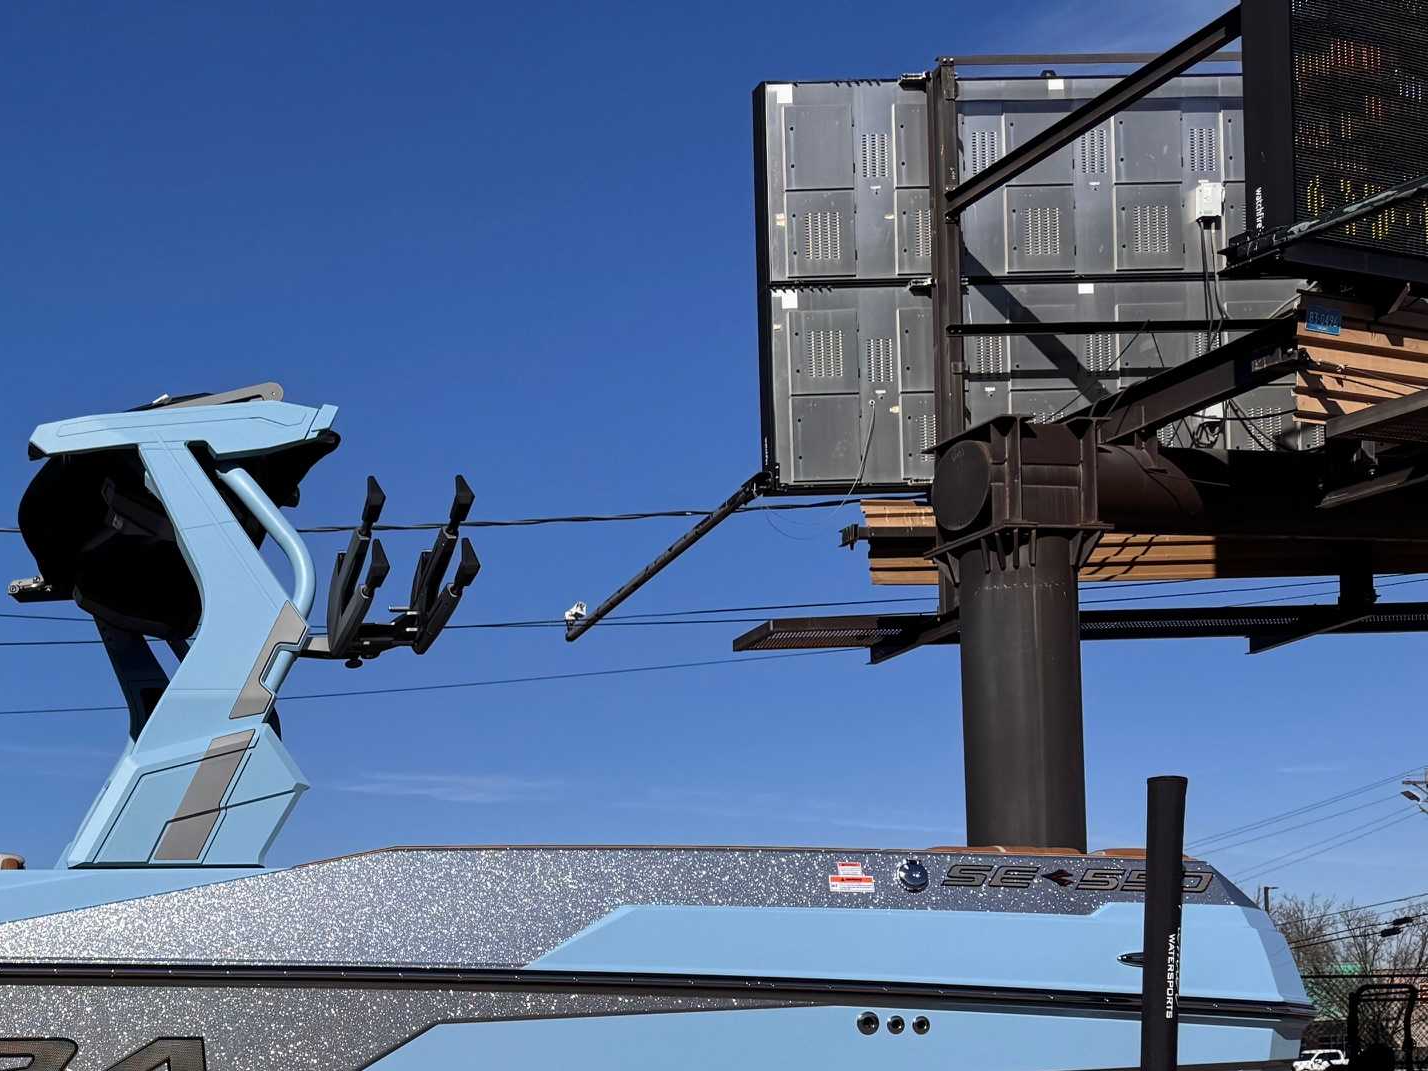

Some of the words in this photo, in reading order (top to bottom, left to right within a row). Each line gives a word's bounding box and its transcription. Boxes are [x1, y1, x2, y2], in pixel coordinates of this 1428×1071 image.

[1255, 187, 1265, 229] watchfire
[941, 864, 1040, 889] SE
[1165, 933, 1176, 1019] WATERSPORTS
